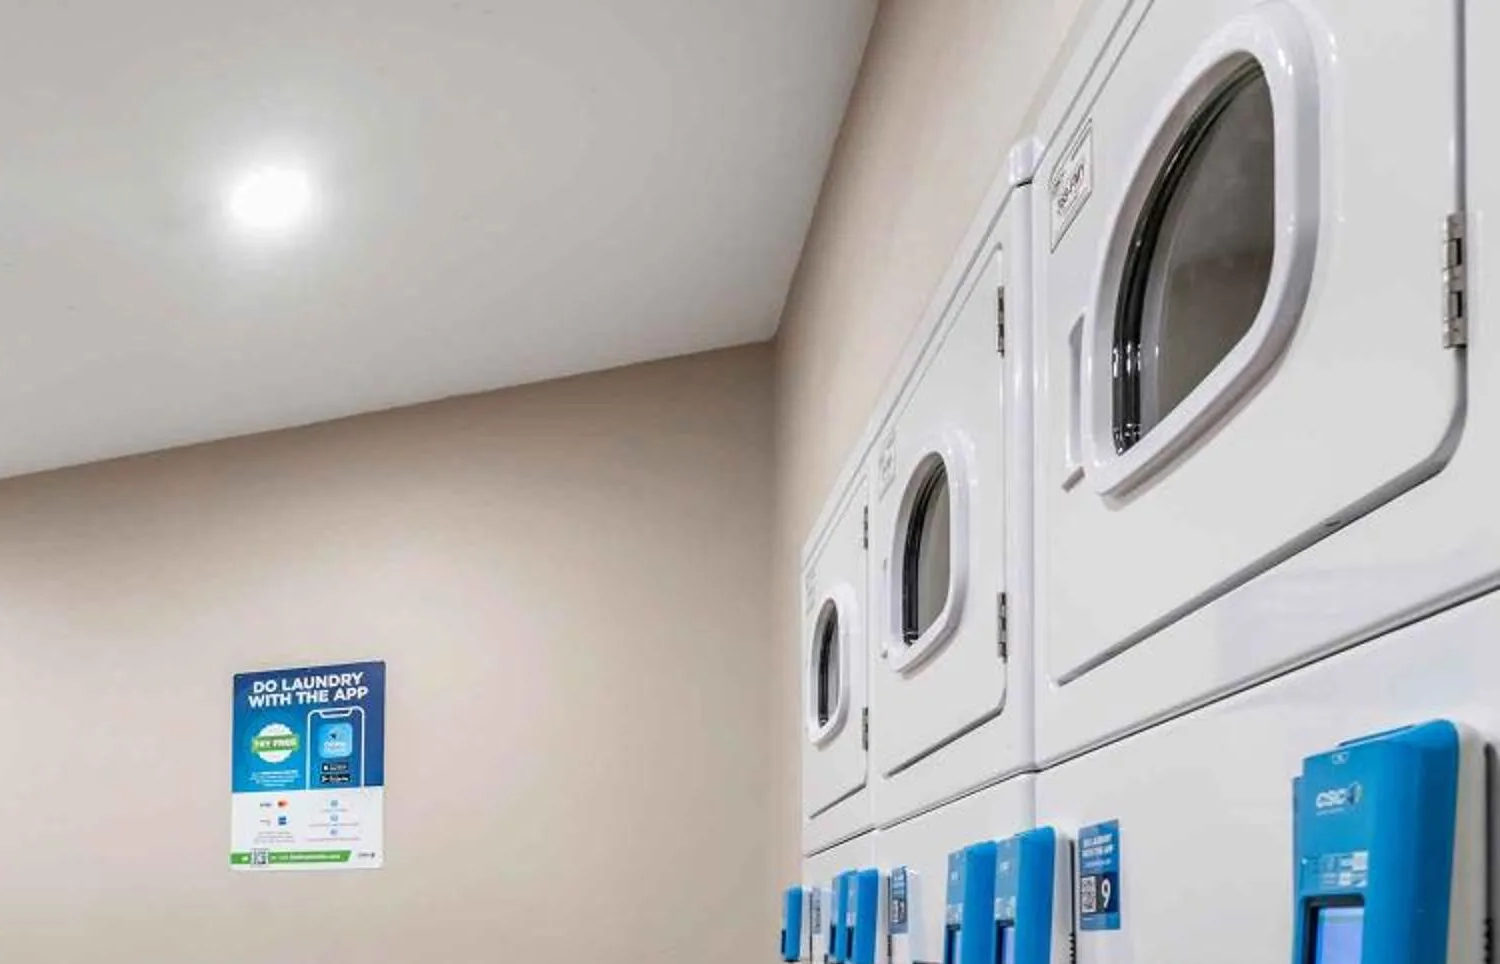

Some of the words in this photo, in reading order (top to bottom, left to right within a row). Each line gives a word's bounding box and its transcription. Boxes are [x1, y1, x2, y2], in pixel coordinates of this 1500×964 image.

[253, 680, 277, 693] DO
[282, 672, 364, 691] LAUNDRY
[248, 693, 292, 708] WITH
[296, 690, 329, 705] THE
[333, 686, 369, 701] APP
[1101, 879, 1111, 908] 9
